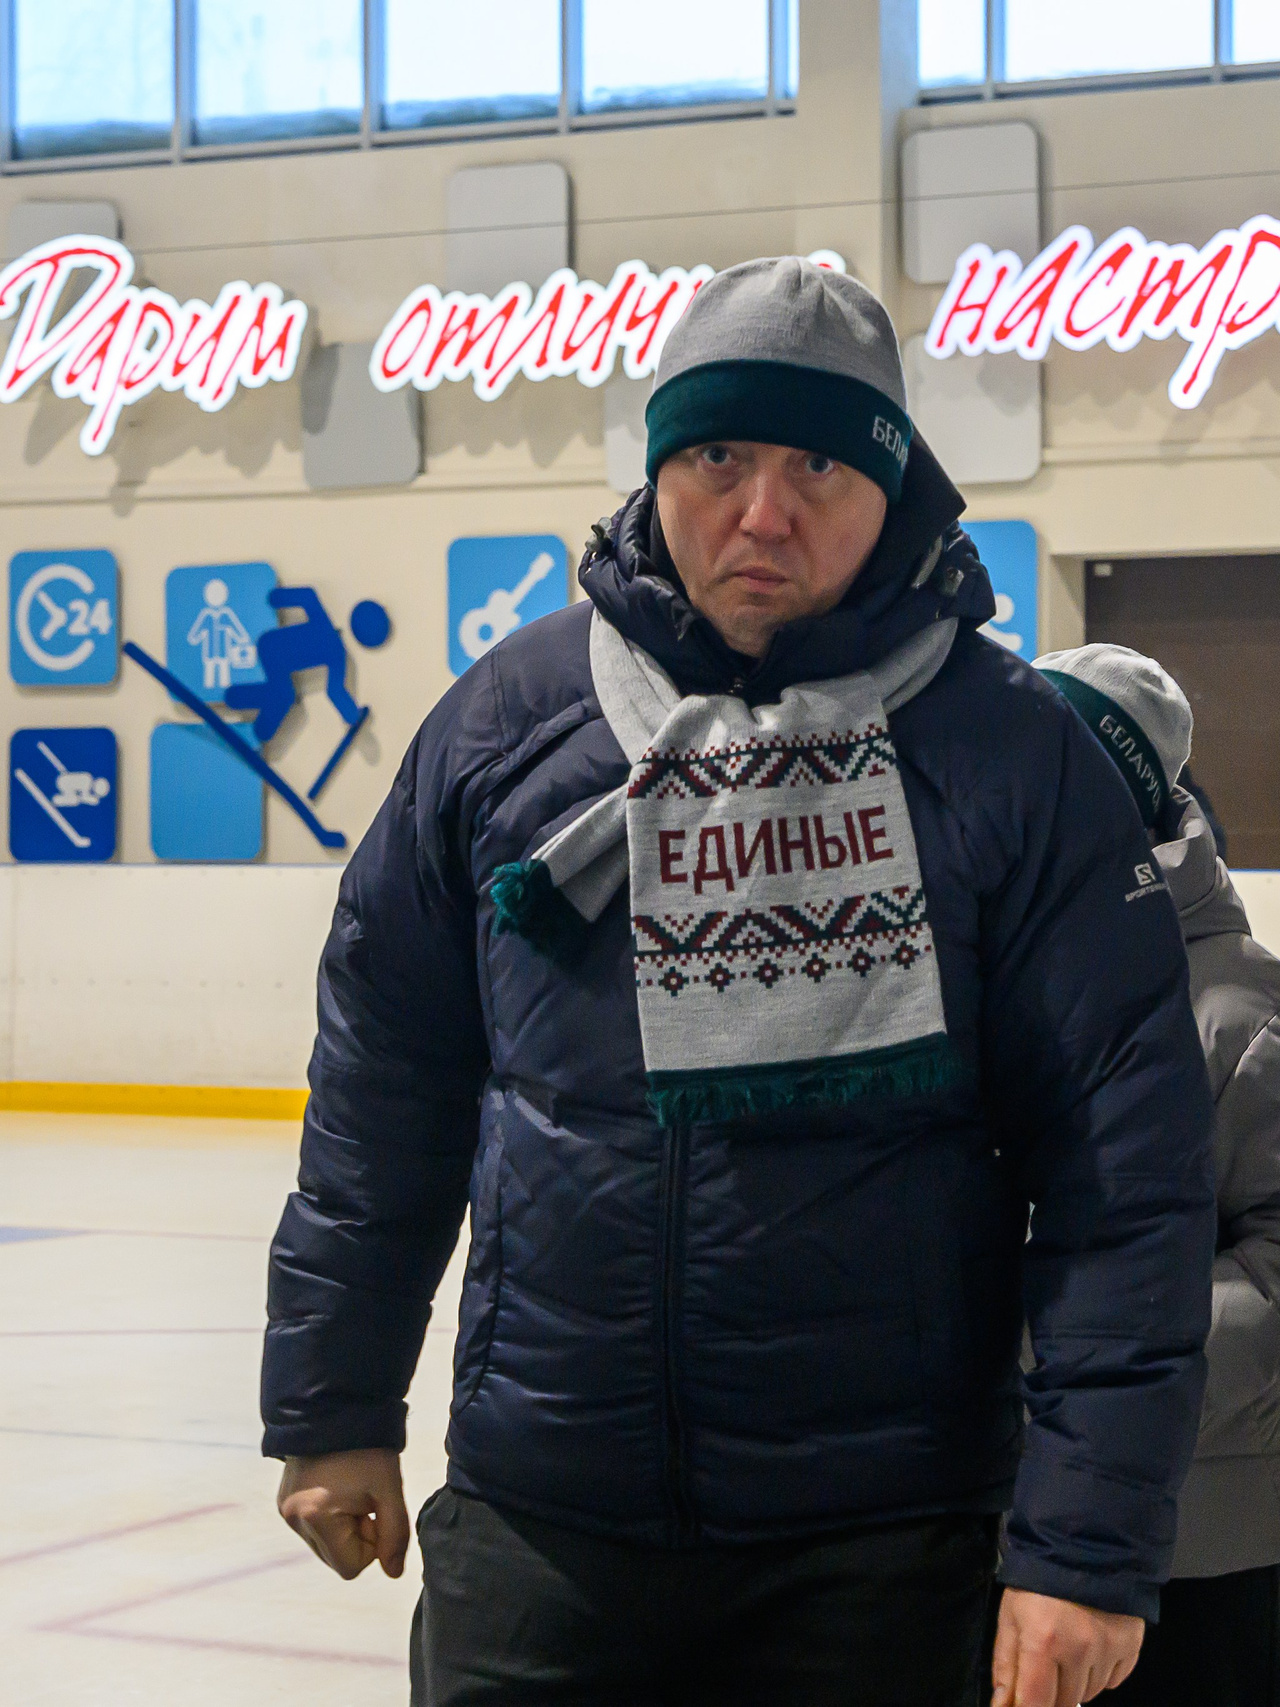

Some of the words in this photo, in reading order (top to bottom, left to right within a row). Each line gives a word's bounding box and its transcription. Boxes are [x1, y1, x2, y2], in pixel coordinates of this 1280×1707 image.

[0, 240, 304, 452] Дарим
[370, 250, 846, 400] отлич
[67, 598, 112, 635] 24
[658, 804, 895, 896] ЕДИНЫЕ
